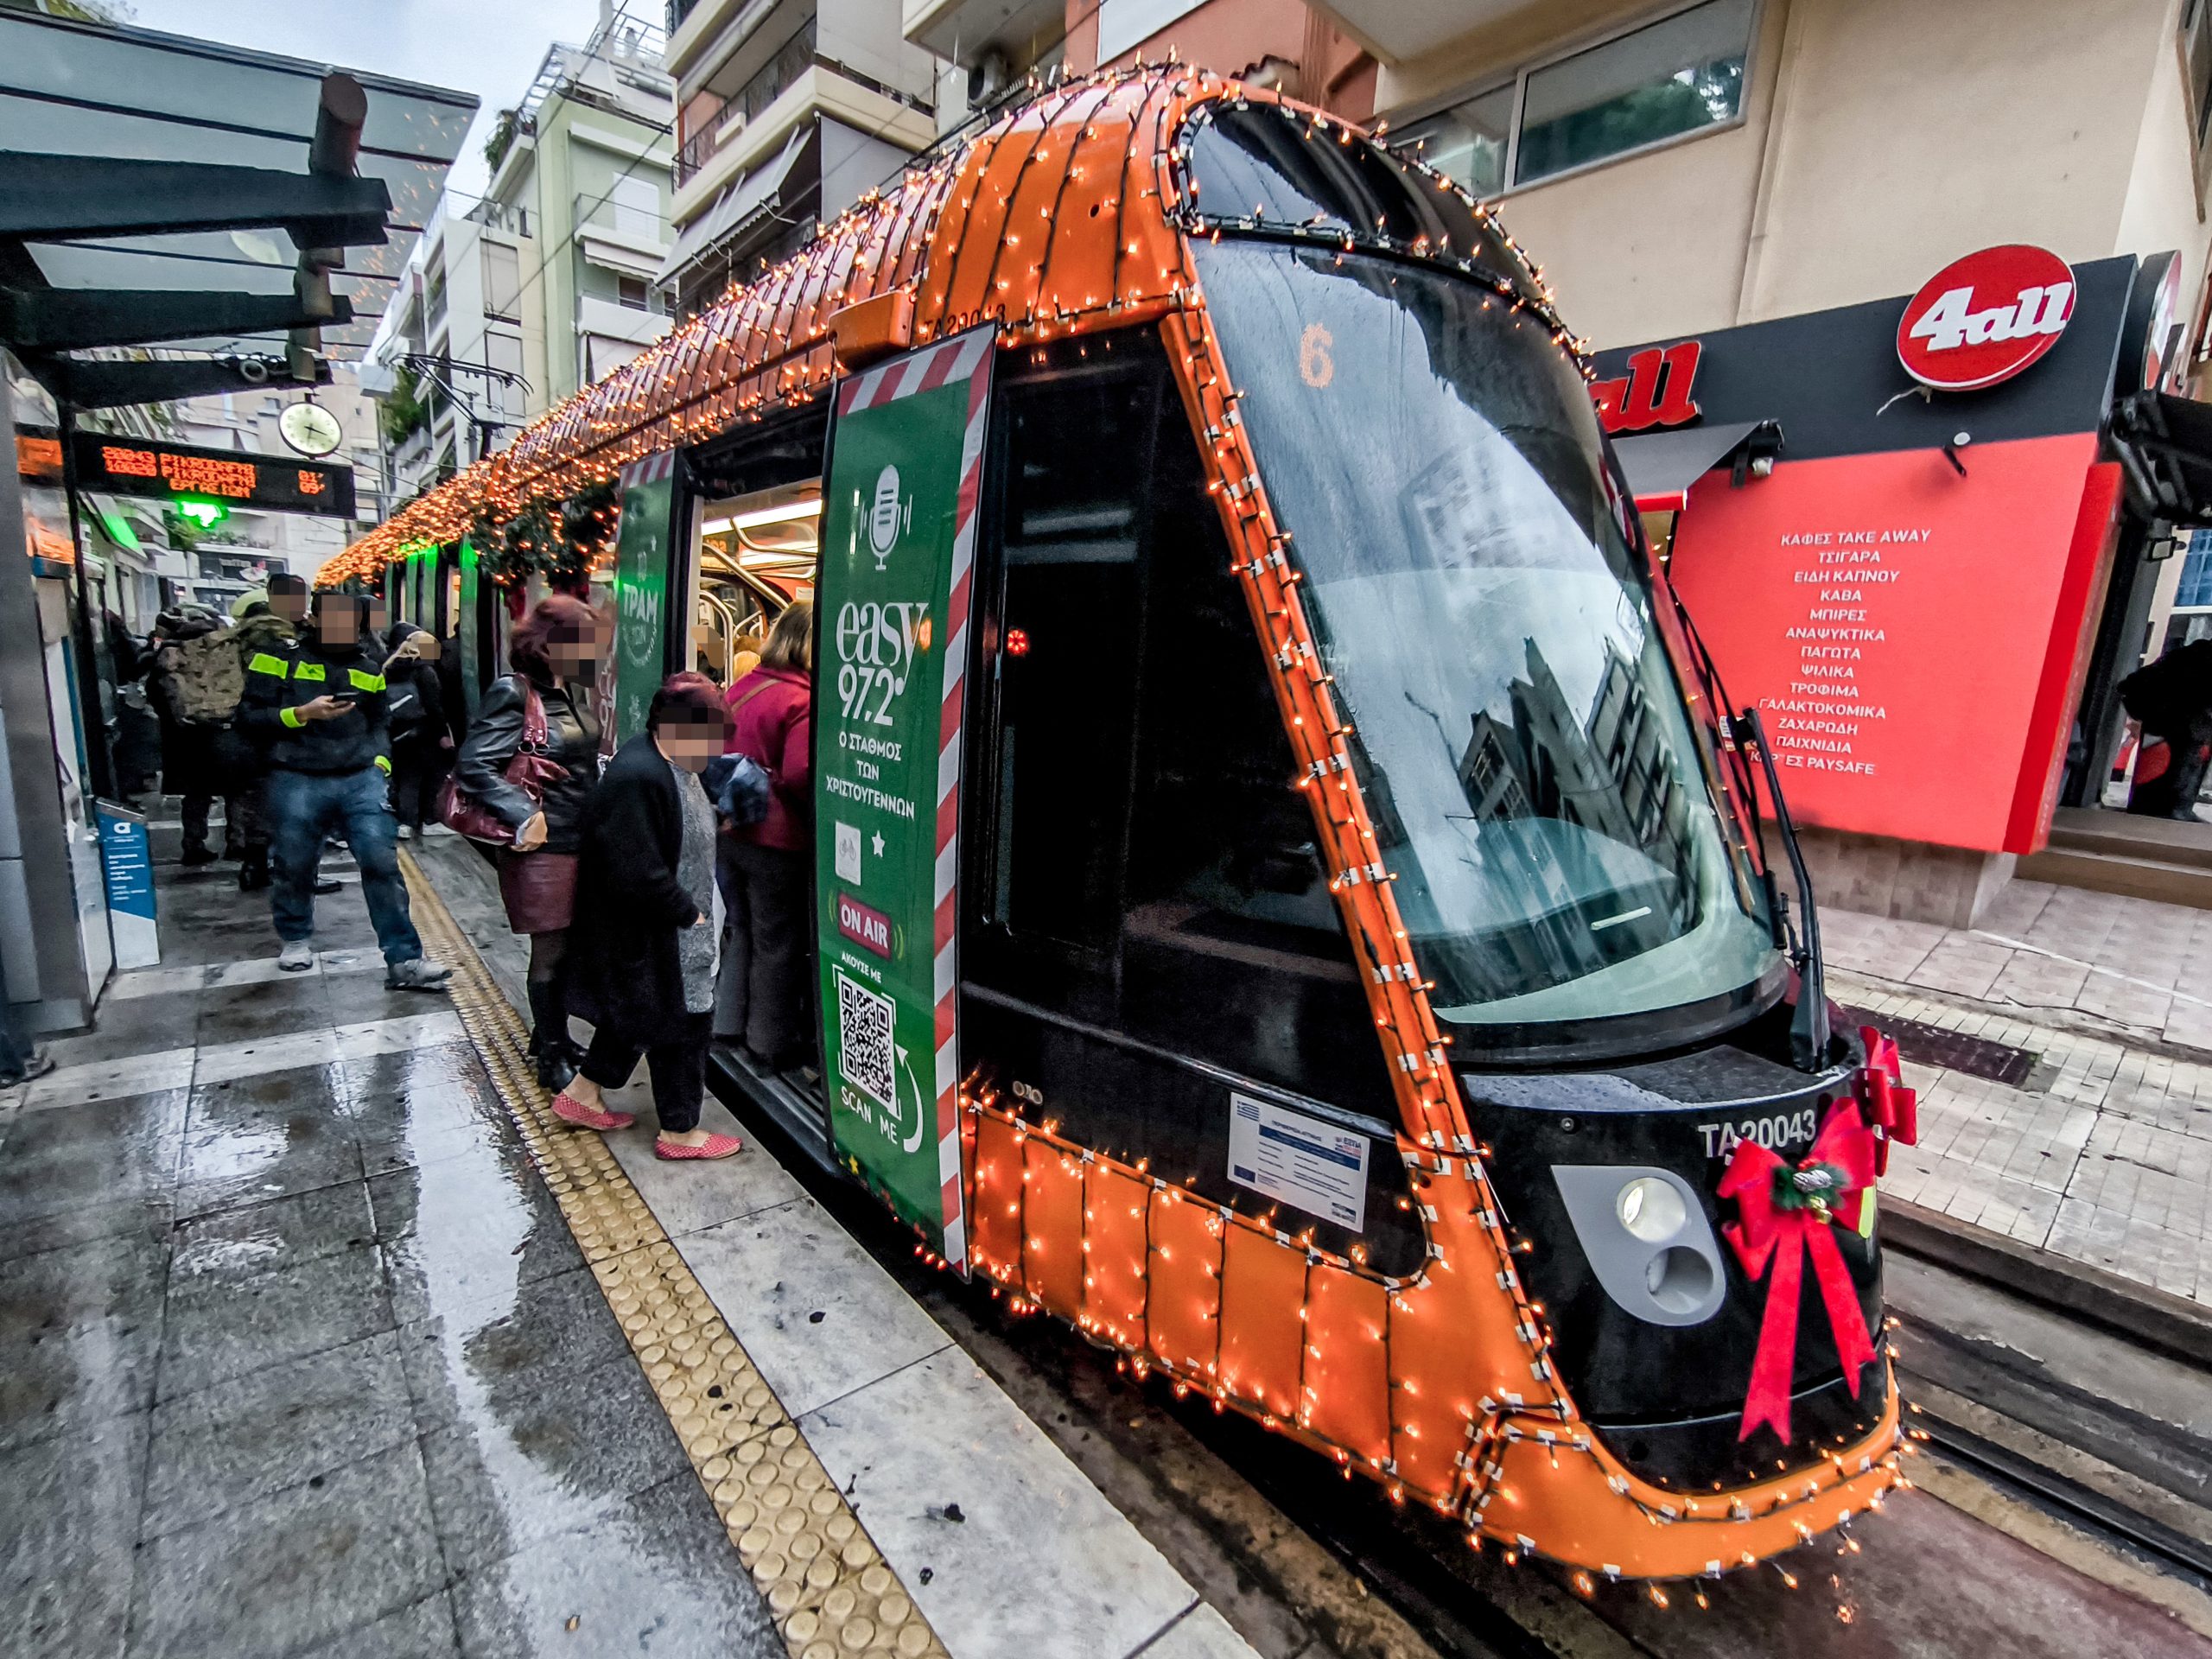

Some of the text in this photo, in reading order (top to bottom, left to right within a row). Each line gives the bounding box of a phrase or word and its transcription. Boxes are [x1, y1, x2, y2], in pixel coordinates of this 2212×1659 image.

[1909, 281, 2073, 352] 4all
[1300, 321, 1333, 389] 6
[1780, 529, 1931, 546] ΚΑΦΕΣ TAKE AWAY
[1818, 550, 1881, 563] ΤΣΙΓΑΡΑ
[1794, 570, 1899, 583] ΕΙΔΗ ΚΑΠΝΟΥ
[1820, 589, 1862, 601] ΚΑΒΑ
[1809, 608, 1867, 621] ΜΠΙΡΕΣ
[1785, 627, 1885, 641] ΑΝΑΨΥΚΤΙΚΑ
[836, 601, 929, 696] easy
[1801, 645, 1861, 659] ΠΑΓΩΤΑ
[1801, 664, 1854, 678] ΨΙΛΙΚΑ
[838, 664, 895, 727] 97.2
[1789, 682, 1859, 697] ΤΡΟΦΙΜΑ
[1758, 698, 1886, 719] ΓΑΛΑΚΤΟΚΟΜΙΚΑ
[1777, 718, 1858, 735] ΖΑΧΑΡΩΔΗ
[839, 731, 902, 761] Ο ΣΤΑΘΜΟΣ
[1776, 735, 1853, 754] ΠΑΙΧΝΙΔΙΑ
[856, 760, 880, 781] ΤΩΝ
[1807, 756, 1876, 775] PAYSAFE
[826, 775, 915, 821] ΧΡΙΣΤΟΥΓΕΝΝΩΝ
[841, 904, 888, 949] ON AIR
[870, 968, 882, 983] ΜΕ
[841, 1085, 898, 1145] SCAN ME
[1698, 1109, 1816, 1158] TA20043
